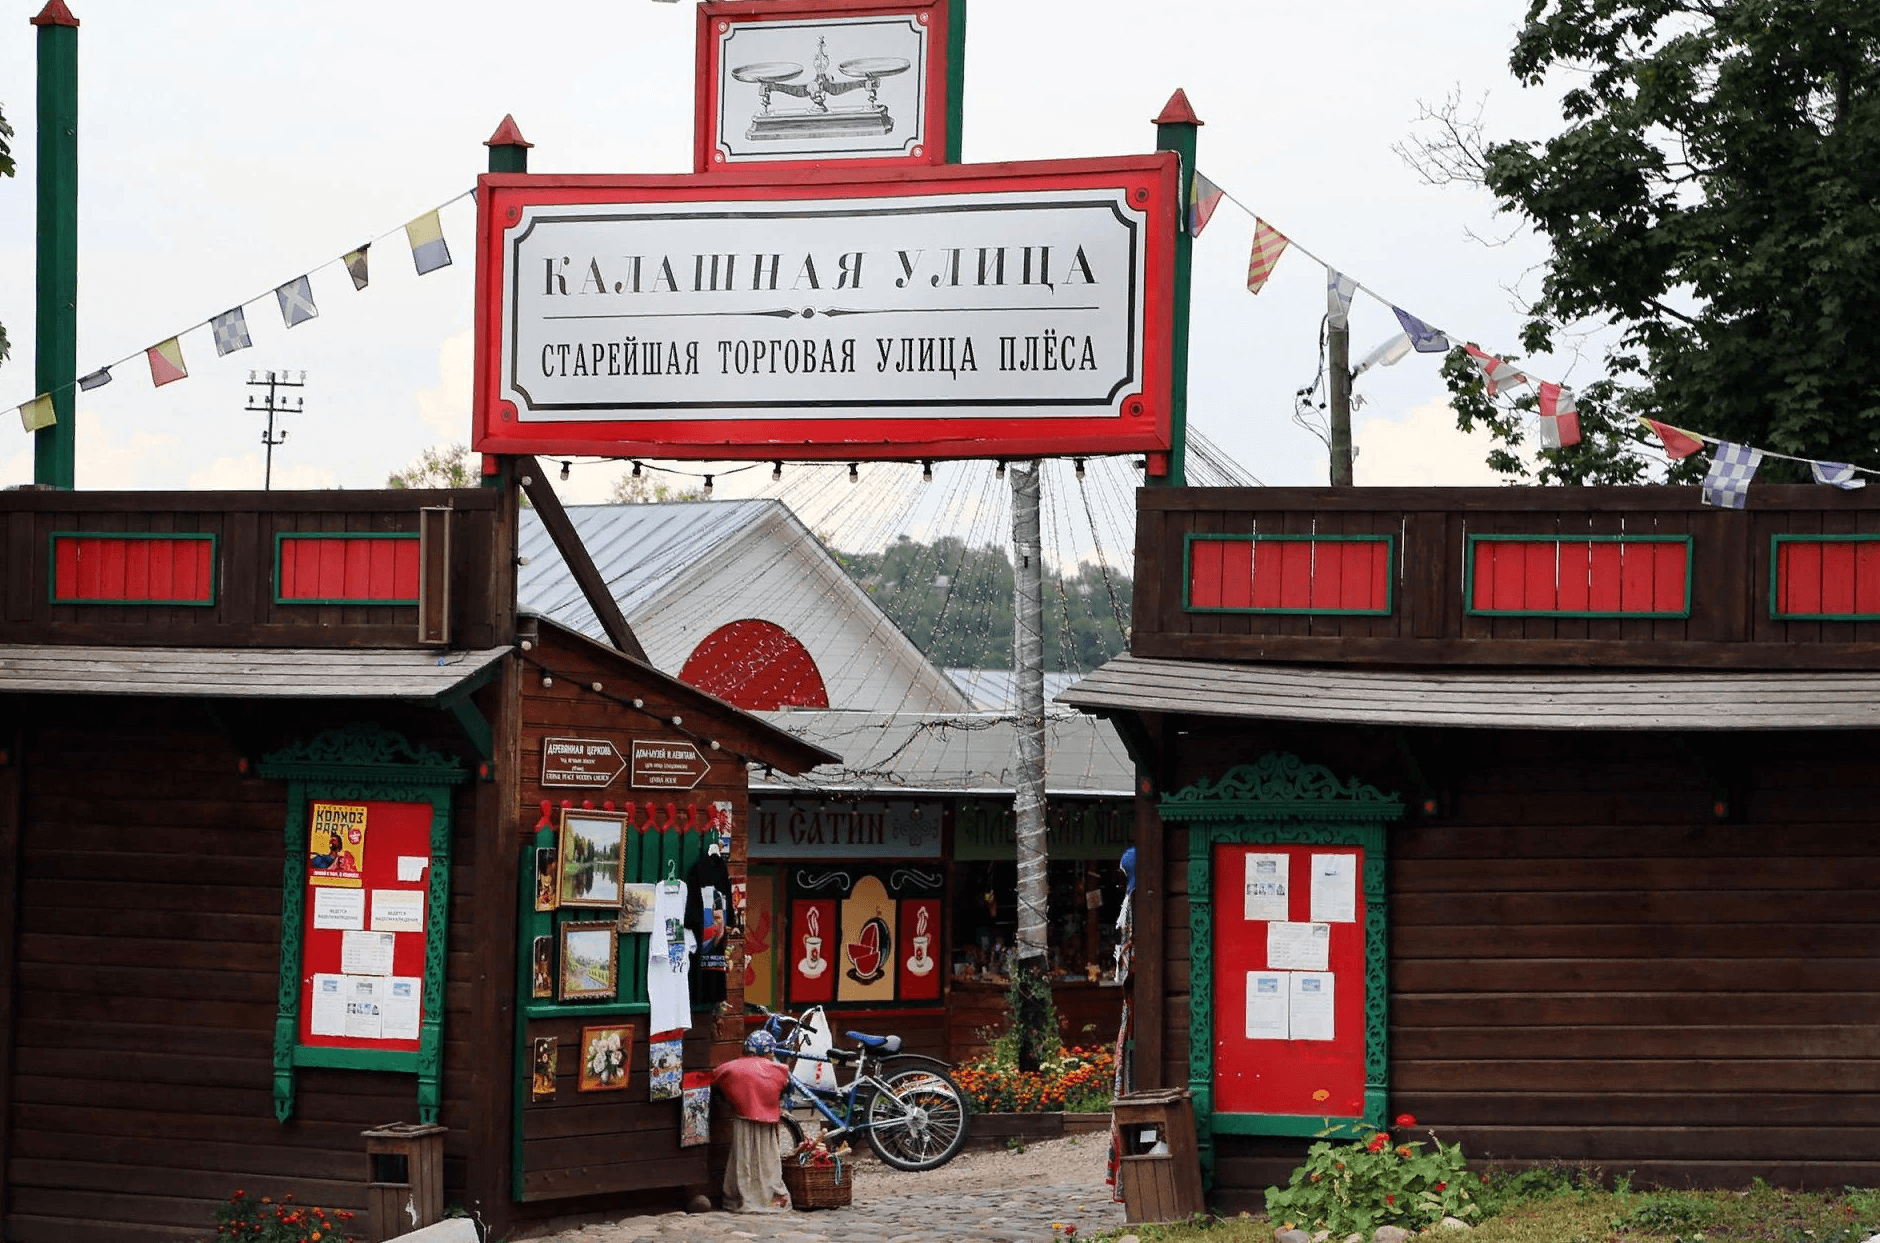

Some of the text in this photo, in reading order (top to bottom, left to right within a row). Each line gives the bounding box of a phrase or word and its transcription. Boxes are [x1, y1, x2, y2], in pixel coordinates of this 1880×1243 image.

[543, 243, 1100, 297] КАЛАШНАЯ УЛИЦА
[541, 328, 1098, 380] СТАРЕЙШАЯ ТОРГОВАЯ УЛИЦА ПЛЁСА
[315, 822, 354, 835] PARTY
[316, 809, 364, 824] КОЛХОЗ
[758, 811, 885, 845] И САТИН
